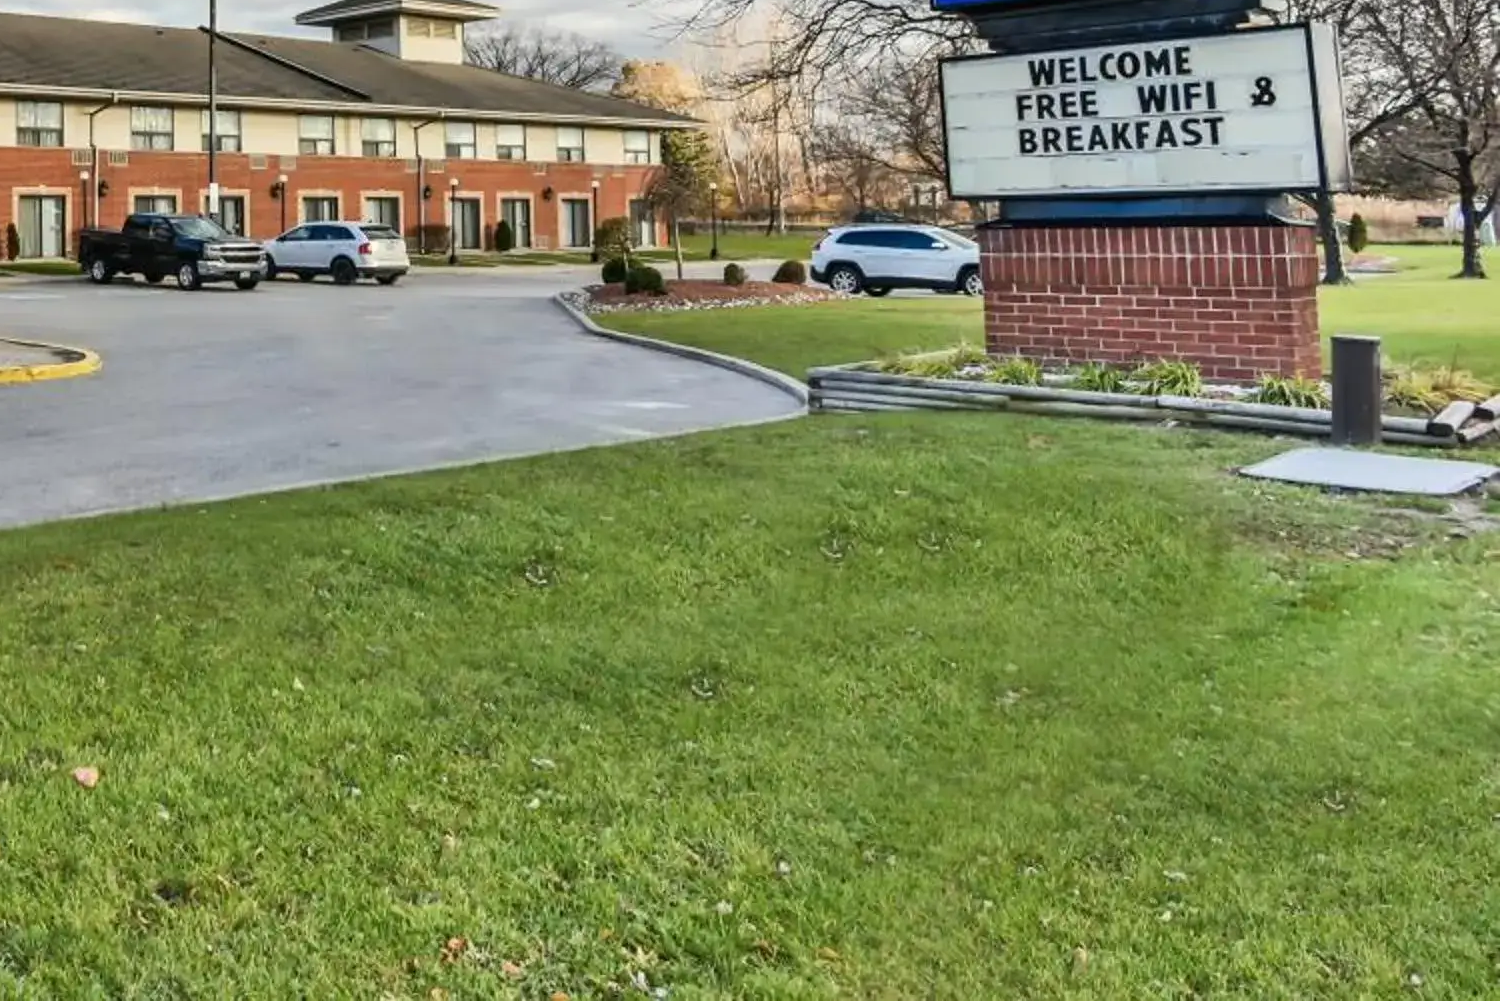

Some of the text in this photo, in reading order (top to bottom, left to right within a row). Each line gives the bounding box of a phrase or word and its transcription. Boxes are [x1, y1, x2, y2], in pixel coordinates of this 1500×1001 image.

[1028, 46, 1192, 86] WELCOME
[1016, 90, 1099, 121] FREE
[1137, 81, 1217, 113] WIFI
[1019, 117, 1224, 153] BREAKFAST
